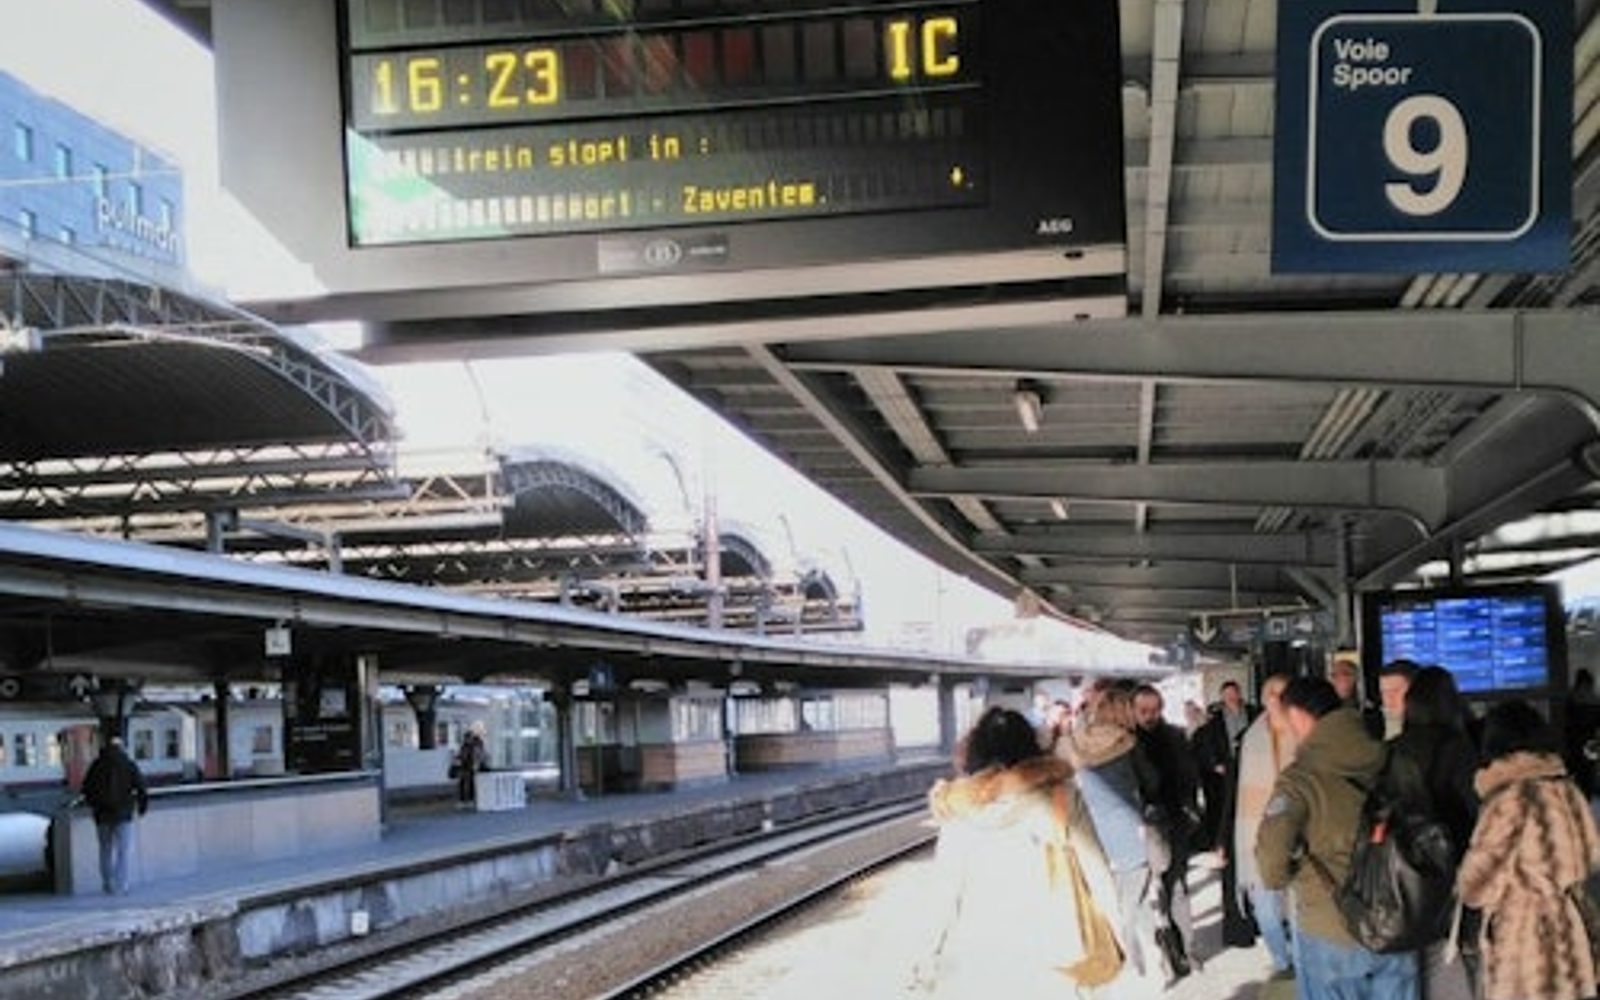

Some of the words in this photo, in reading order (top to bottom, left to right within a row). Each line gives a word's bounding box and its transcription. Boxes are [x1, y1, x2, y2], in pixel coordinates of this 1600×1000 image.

[372, 48, 560, 115] 16:23
[887, 17, 960, 79] IC
[1333, 38, 1390, 60] Voie
[1333, 63, 1413, 90] Spoor
[549, 135, 628, 167] stopt
[650, 133, 681, 161] in
[1383, 94, 1469, 216] 9
